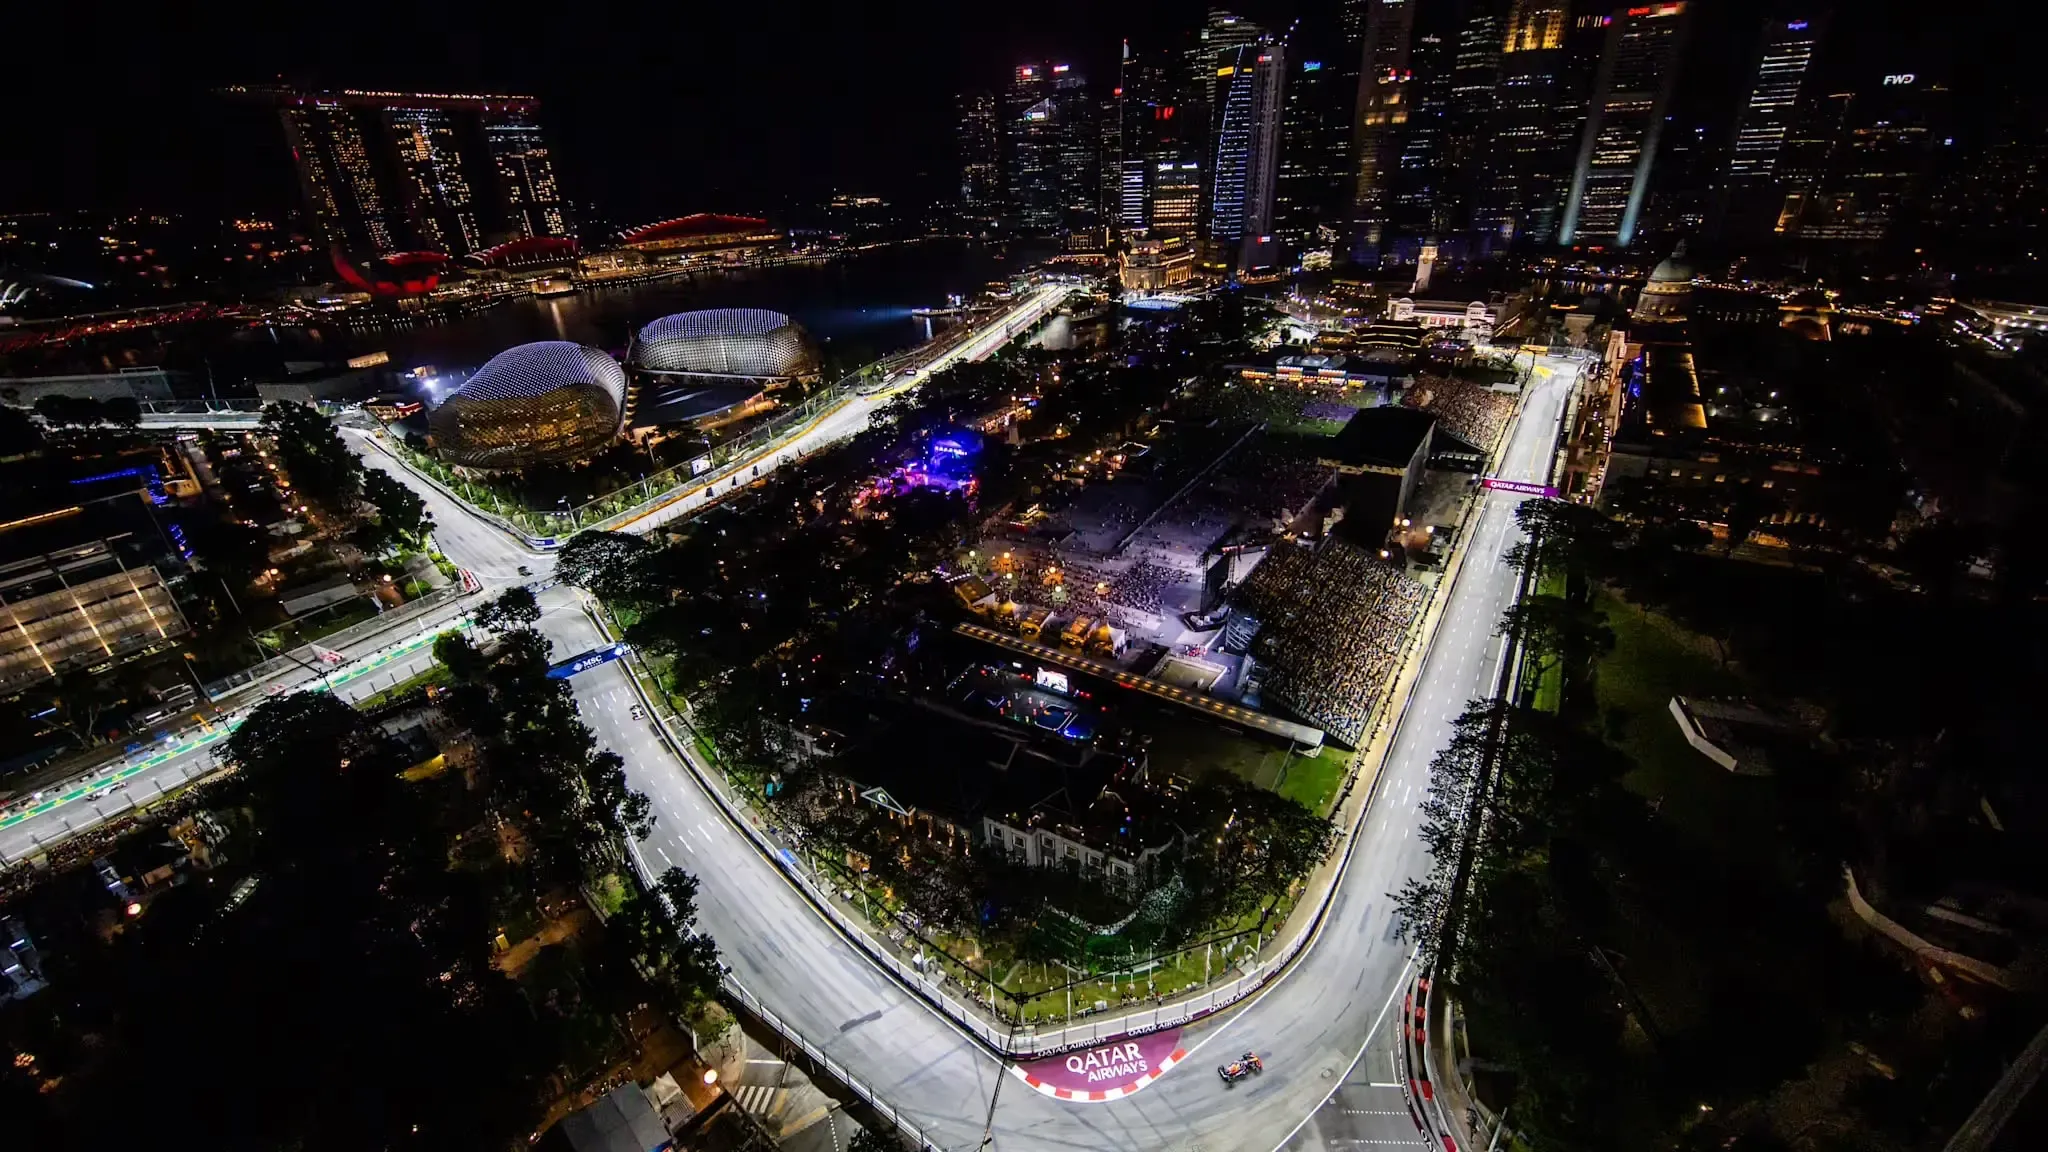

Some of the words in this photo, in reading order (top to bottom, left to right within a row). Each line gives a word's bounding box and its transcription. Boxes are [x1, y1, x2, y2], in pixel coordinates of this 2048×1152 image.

[1883, 74, 1914, 85] FWD
[1490, 481, 1514, 489] QATAR
[1515, 484, 1545, 493] AIRWAYS
[582, 655, 602, 667] MSC
[1128, 1024, 1157, 1037] QATAR
[1158, 1015, 1194, 1029] AIRWAYS
[1038, 1045, 1068, 1057] QATAR
[1069, 1037, 1107, 1050] AIRWAYS
[1066, 1043, 1143, 1074] QATAR
[1088, 1060, 1148, 1082] AIRWAYS
